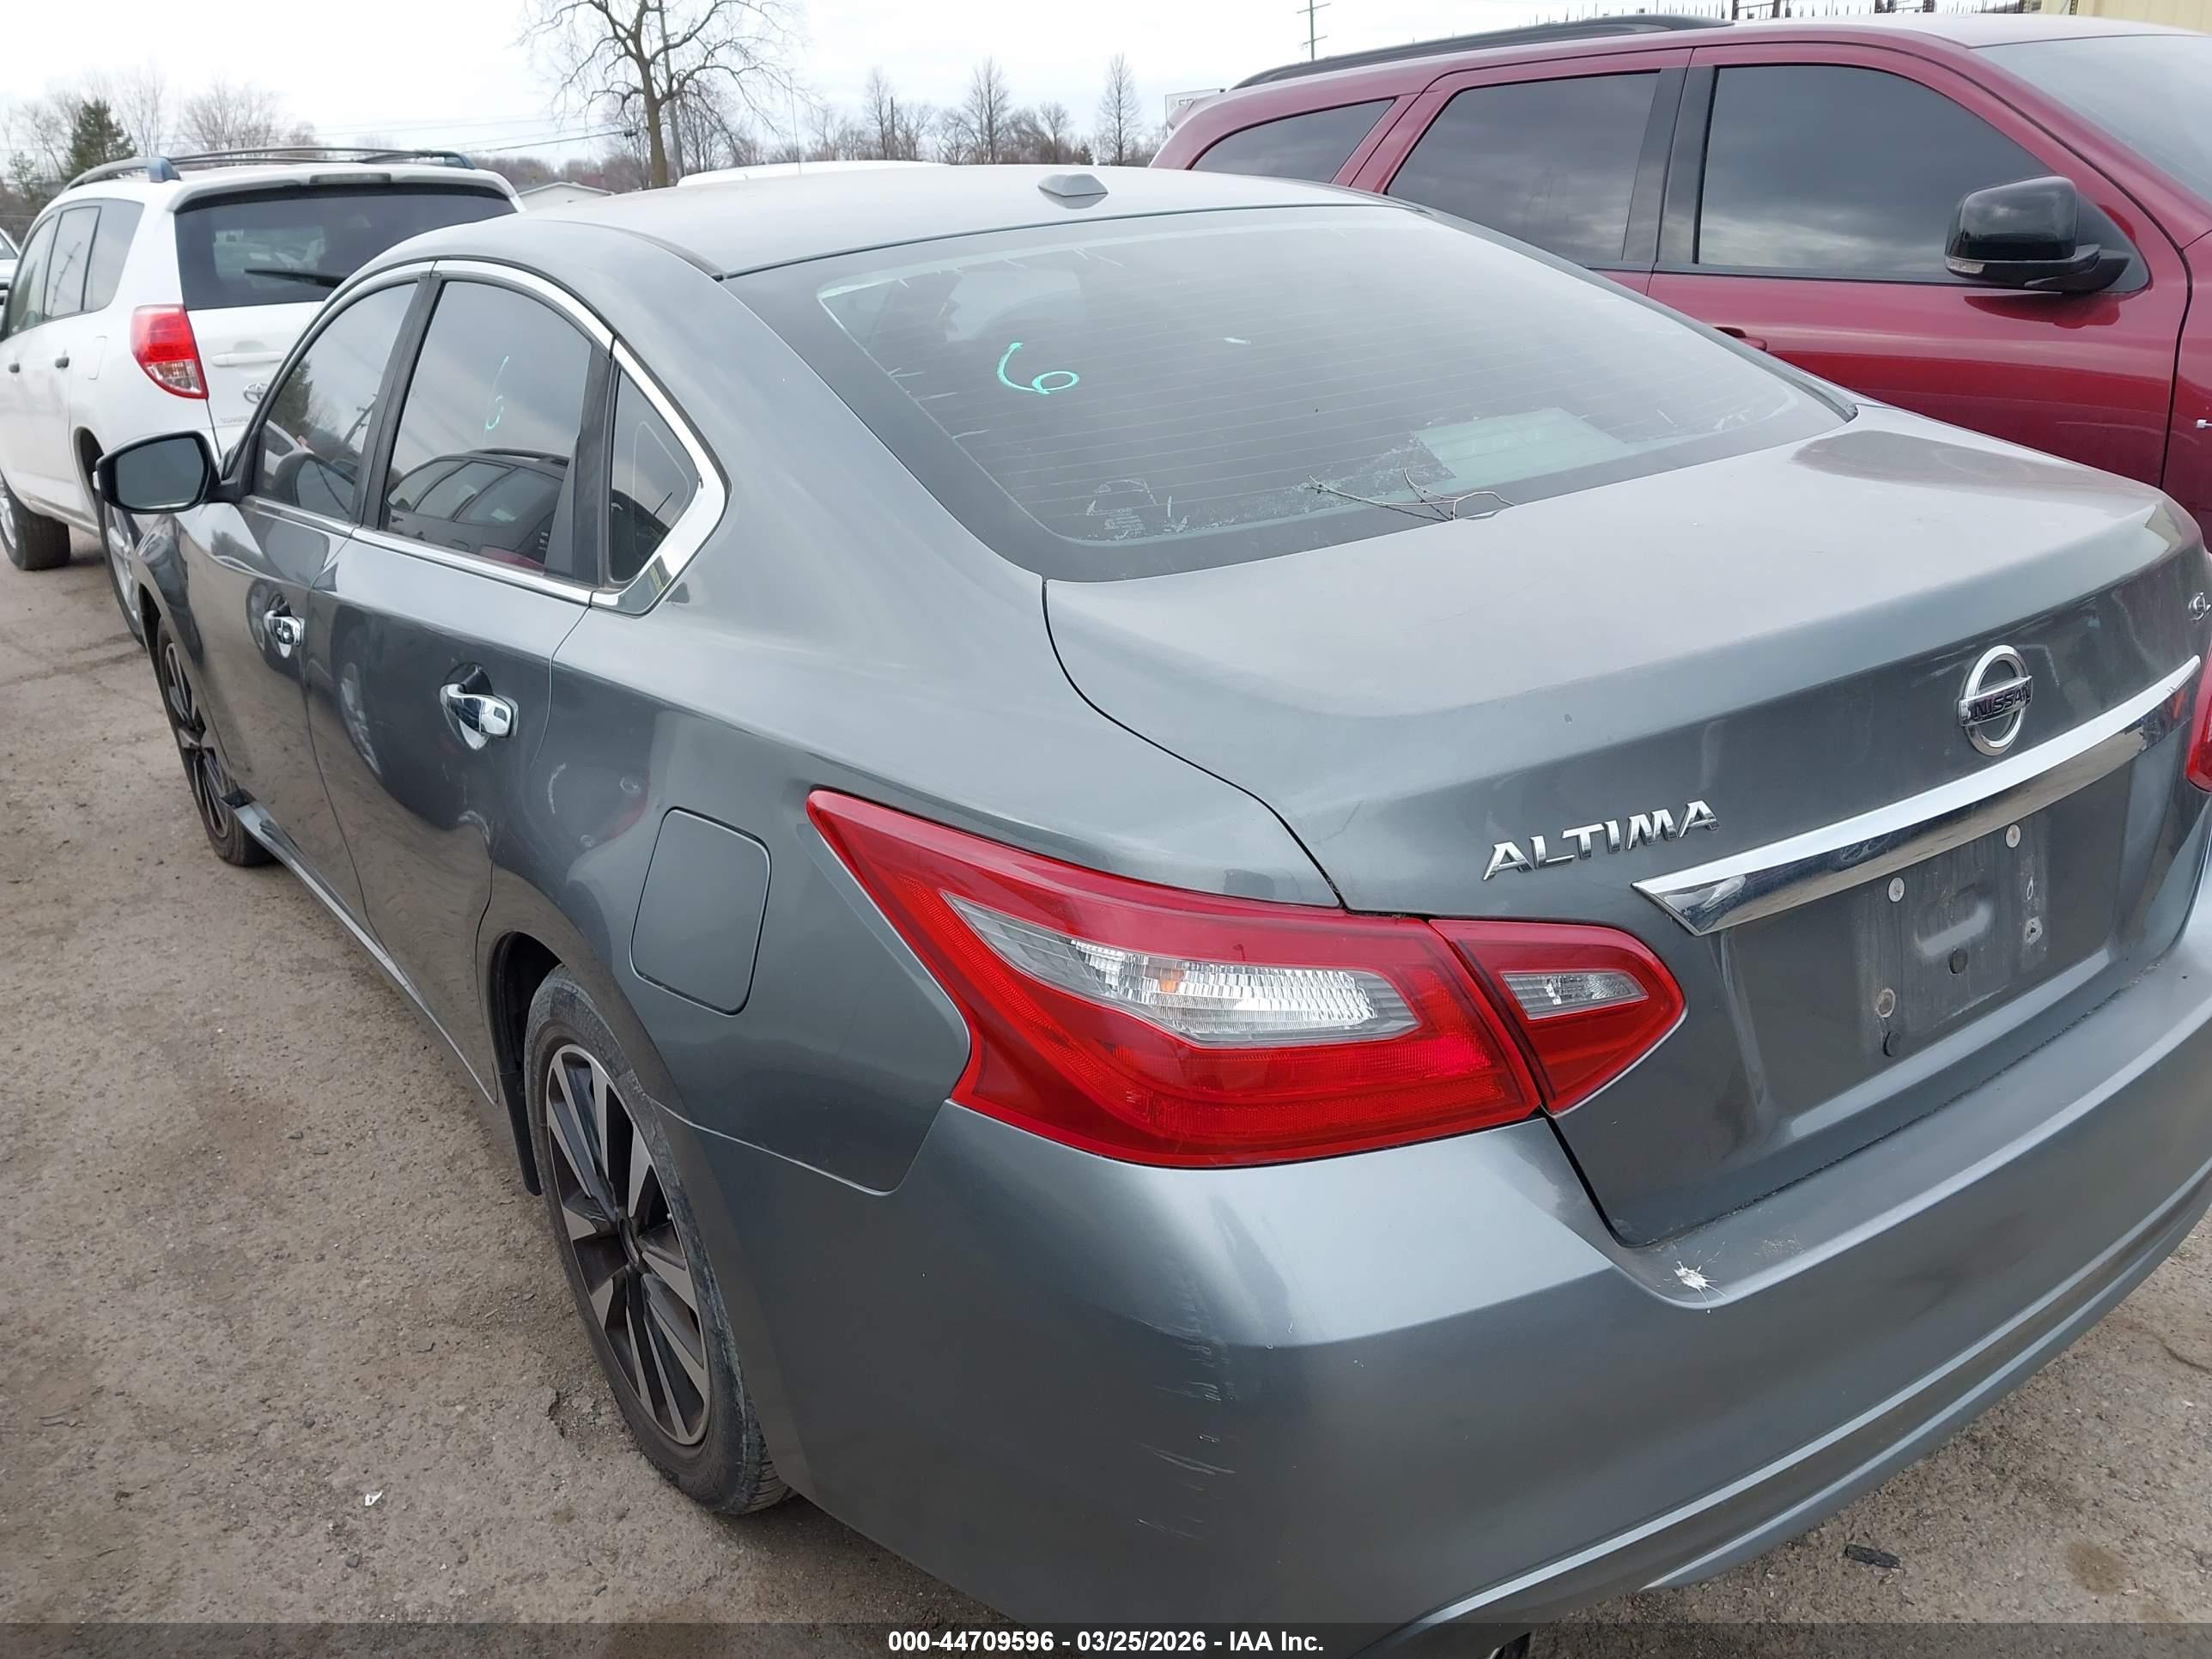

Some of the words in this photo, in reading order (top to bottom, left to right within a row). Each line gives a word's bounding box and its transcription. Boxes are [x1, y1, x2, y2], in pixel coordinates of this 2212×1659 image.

[996, 342, 1079, 395] 6
[1972, 682, 2032, 722] NISSAN
[1482, 799, 1719, 881] ALTIMA
